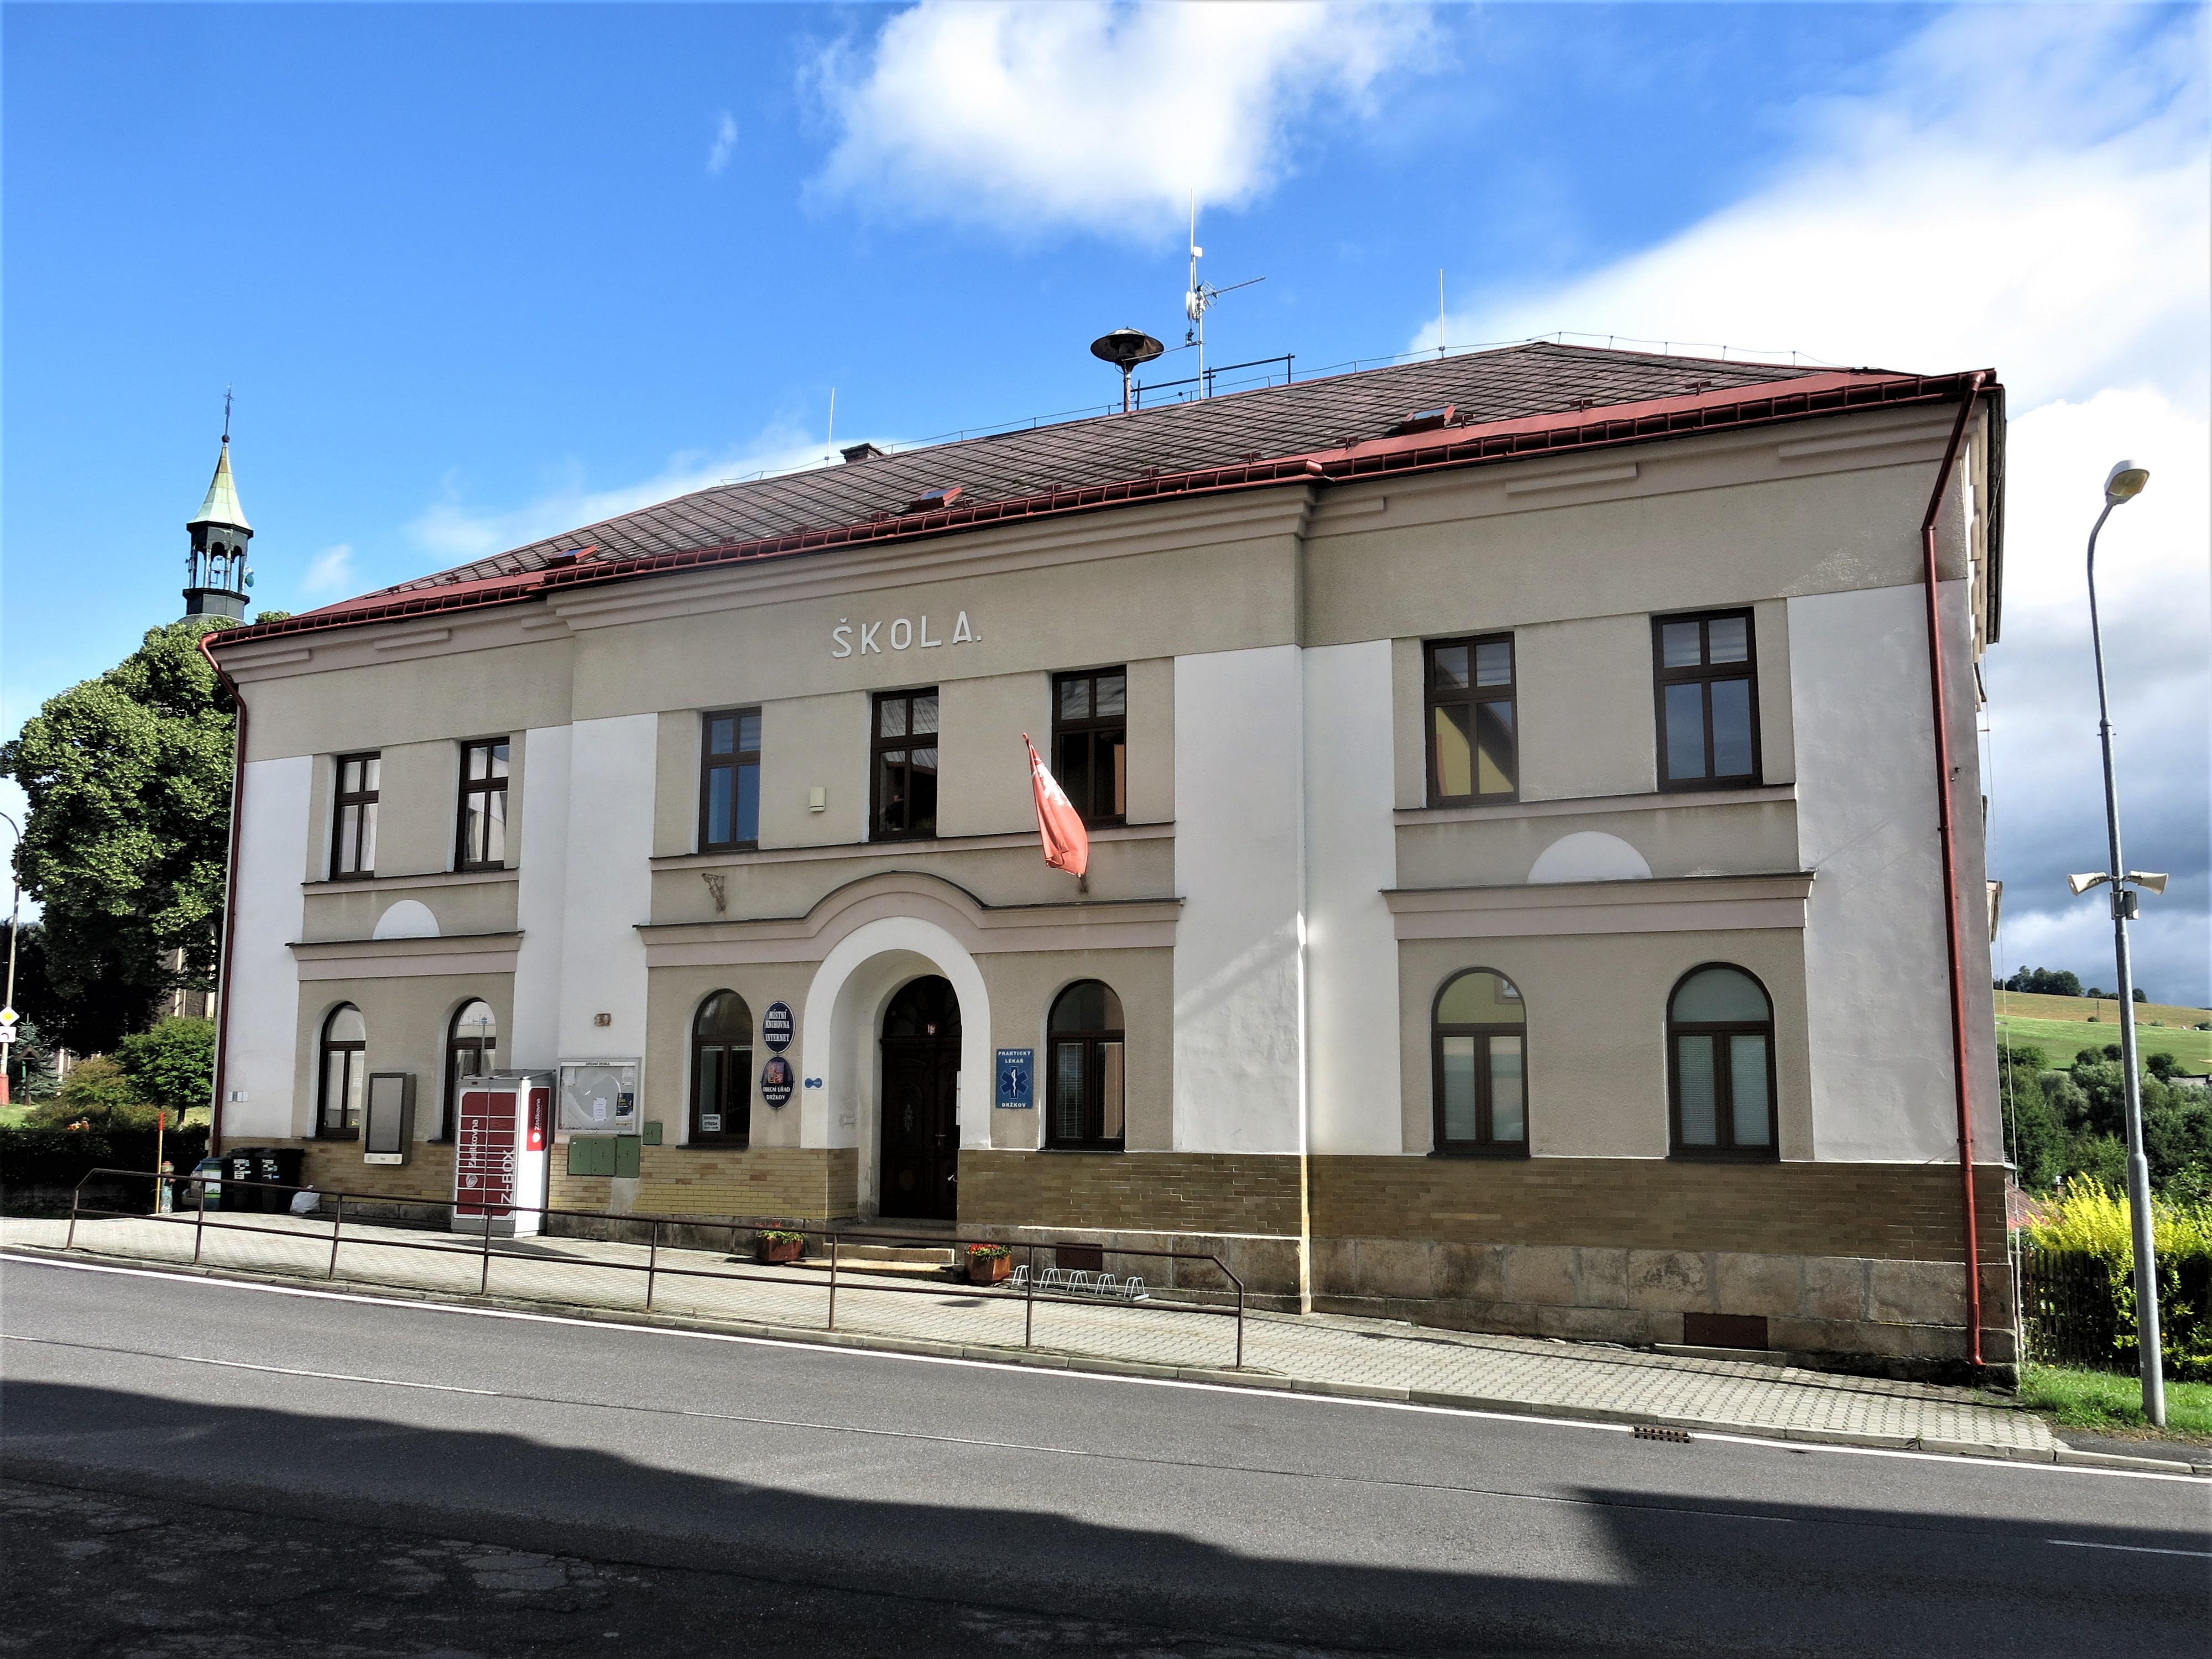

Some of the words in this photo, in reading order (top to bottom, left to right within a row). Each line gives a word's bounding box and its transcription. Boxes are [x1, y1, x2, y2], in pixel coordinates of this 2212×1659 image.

[769, 1009, 787, 1020] MÍSTNÍ
[765, 1020, 790, 1029] KNIHOVNA
[765, 1034, 790, 1042] INTERNET
[500, 1149, 515, 1203] Z-BOX
